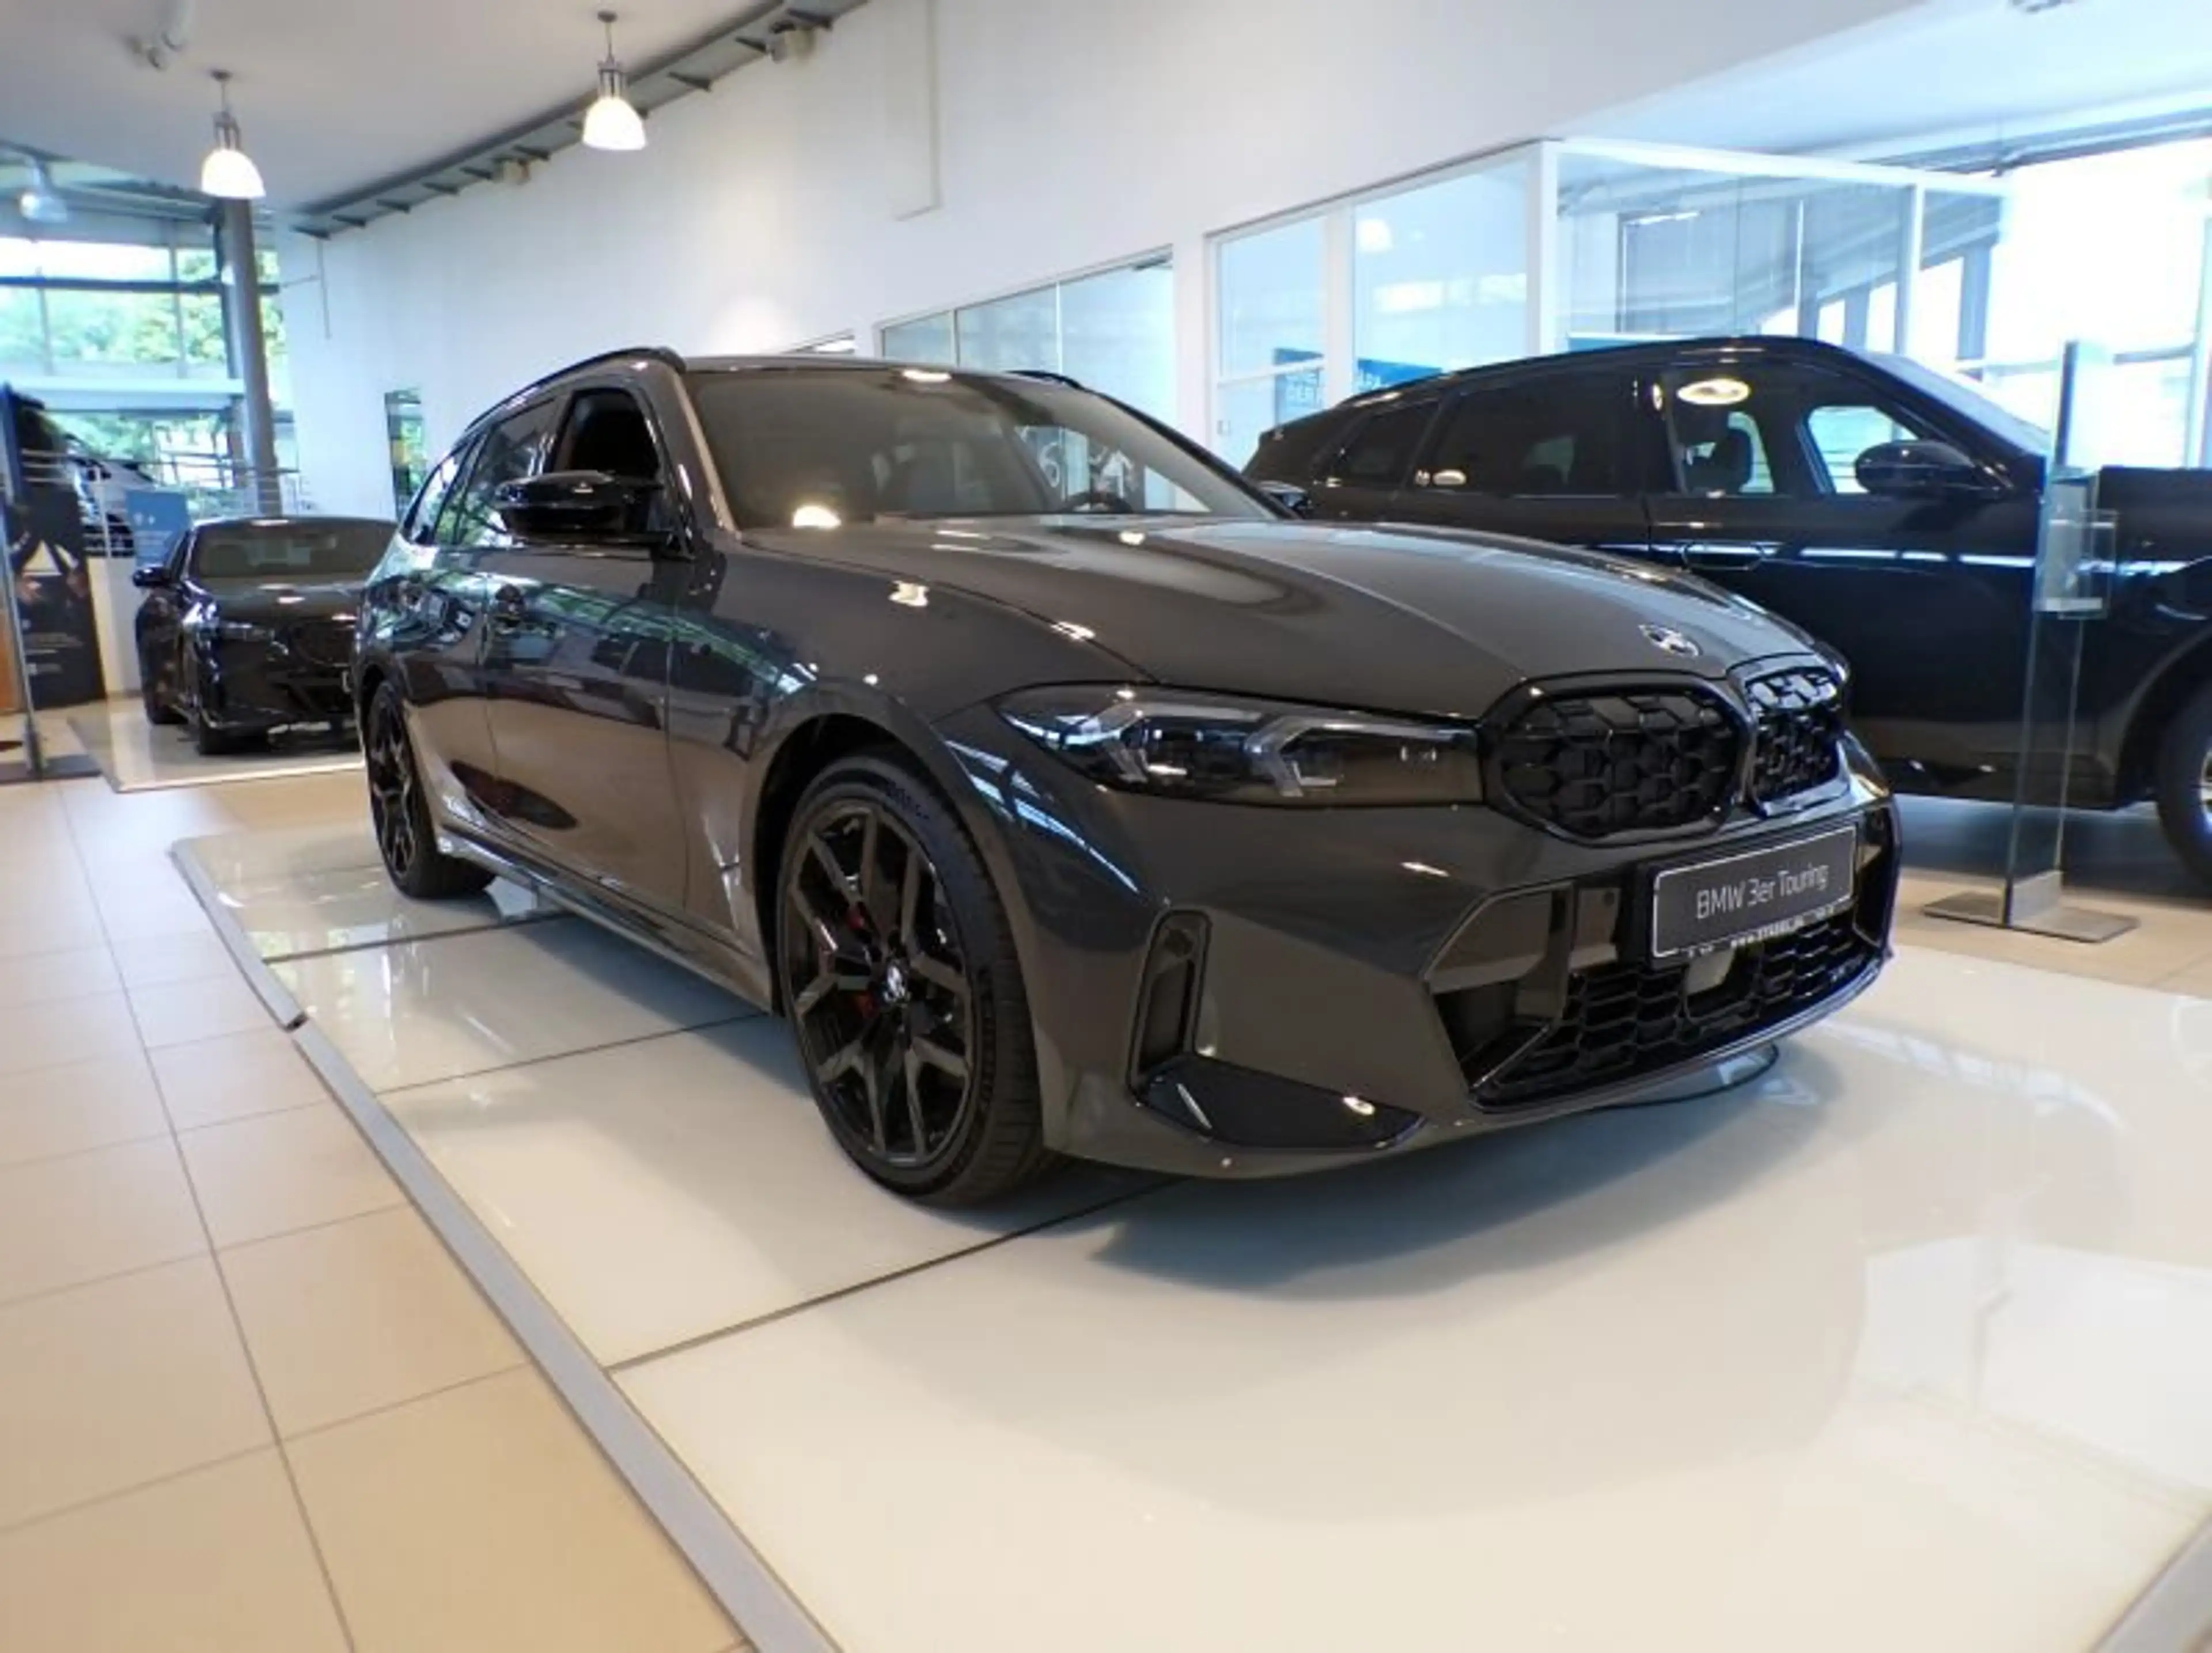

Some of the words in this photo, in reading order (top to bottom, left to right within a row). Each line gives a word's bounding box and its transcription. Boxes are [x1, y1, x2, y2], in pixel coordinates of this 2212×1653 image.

[1696, 880, 1745, 919] BMW
[1747, 878, 1776, 908] 3er
[1778, 862, 1830, 897] Touring
